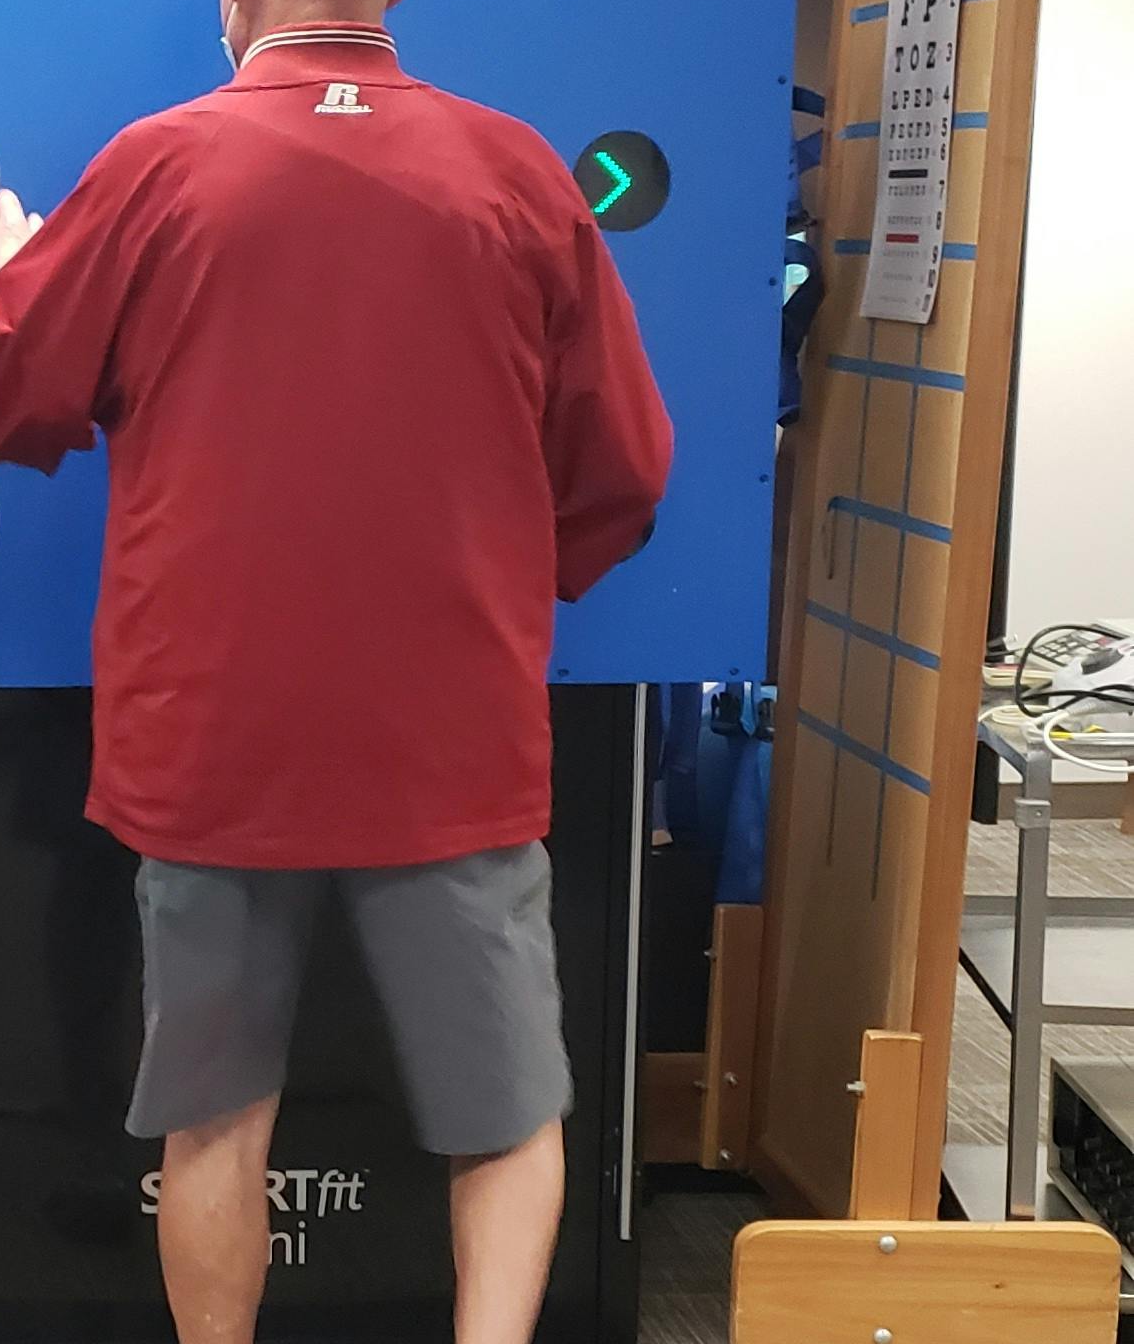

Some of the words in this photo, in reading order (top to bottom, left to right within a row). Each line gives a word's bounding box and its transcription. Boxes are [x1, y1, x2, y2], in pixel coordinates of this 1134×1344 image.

[945, 41, 953, 63] 3
[943, 84, 950, 105] 4
[938, 179, 945, 200] 7
[140, 1168, 365, 1218] SRTfit
